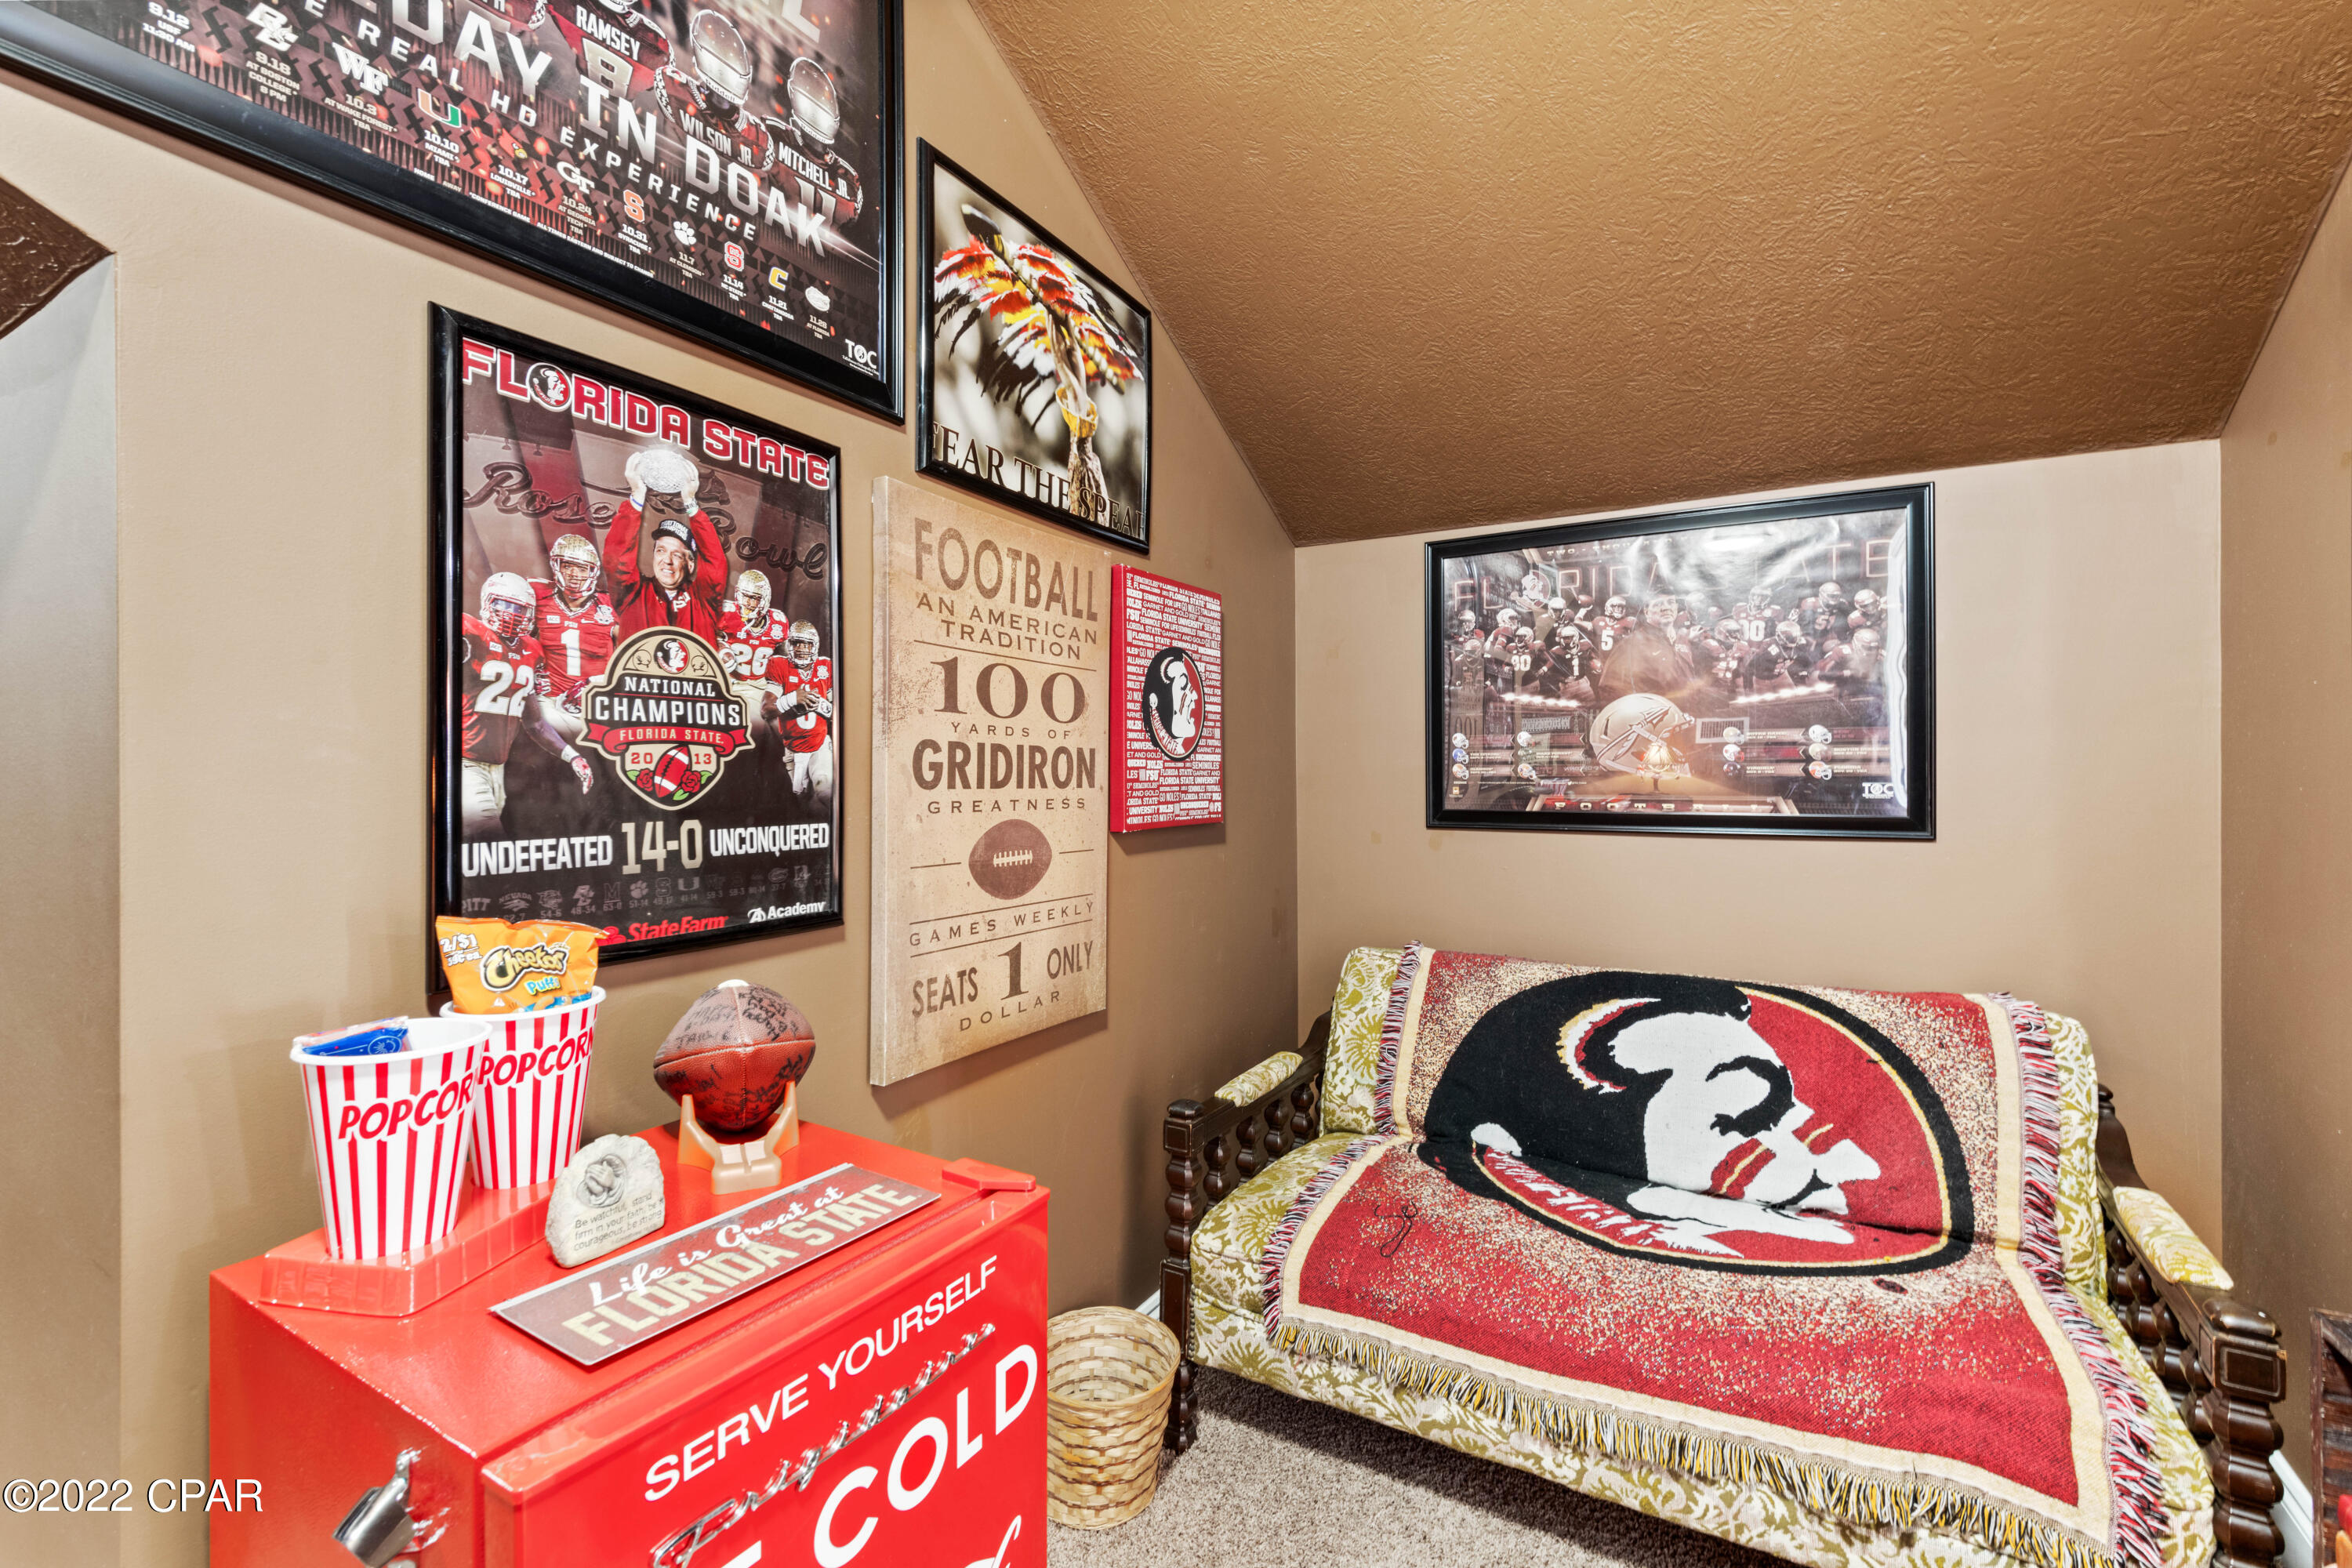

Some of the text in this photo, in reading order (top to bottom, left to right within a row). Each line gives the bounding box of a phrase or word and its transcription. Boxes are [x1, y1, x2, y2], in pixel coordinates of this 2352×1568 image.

[147, 2, 190, 29] 9.12
[175, 38, 195, 53] AM
[576, 5, 641, 61] RAMSEY
[245, 60, 300, 90] AT BOSTON
[255, 50, 292, 76] 9.18
[269, 89, 287, 102] PM
[324, 97, 336, 107] AT
[335, 101, 363, 119] WAKE
[345, 93, 377, 116] 10.3
[352, 118, 372, 132] TBA
[424, 129, 459, 154] 10.10
[679, 109, 755, 168] WILSON JR.
[434, 154, 451, 167] TBA
[491, 89, 537, 127] HD
[560, 125, 757, 241] EXPERIENCE
[579, 74, 826, 257] IN DOAK
[779, 142, 833, 191] MITCHELL
[414, 167, 436, 181] HOME
[497, 164, 529, 186] 10.17
[505, 187, 521, 199] TBA
[563, 194, 592, 216] 10.24
[513, 210, 532, 223] GAME
[557, 205, 597, 227] AT GEORGIA
[570, 224, 584, 236] TBA
[622, 223, 648, 244] 10.31
[536, 221, 547, 230] ALL
[547, 227, 567, 239] TIMES
[567, 235, 592, 251] EASTERN
[591, 245, 604, 256] AND
[603, 251, 627, 267] SUBJECT
[626, 260, 635, 269] TO
[629, 244, 641, 255] TBA
[678, 251, 695, 266] 11.7
[723, 274, 744, 290] 11.14
[768, 295, 788, 311] 11.21
[844, 338, 877, 369] TOC
[462, 336, 830, 491] FLORIDA STATE
[1014, 457, 1072, 510] THE
[914, 517, 1098, 622] FOOTBALL
[1142, 601, 1189, 619] GARNET AND GOLD
[1169, 592, 1189, 604] FLORIDA
[915, 593, 955, 616] AN
[969, 606, 1098, 645] AMERICAN
[1142, 608, 1162, 622] FLORIDA
[1163, 613, 1177, 625] STATE
[941, 619, 1081, 660] TRADITION
[1132, 630, 1154, 643] FLORIDA
[1600, 630, 1614, 651] 5
[561, 628, 582, 677] 1
[730, 642, 774, 677] 26
[474, 659, 535, 718] 22
[624, 676, 716, 697] NATIONAL
[930, 655, 1086, 724] 100
[595, 696, 740, 726] CHAMPIONS
[620, 728, 677, 741] FLORIDA
[951, 721, 1072, 740] YARDS OF
[912, 739, 1096, 790] GRIDIRON
[928, 798, 1086, 814] GREATNESS
[462, 818, 829, 877] UNDEFEATED 14-0 UNCONQUERED
[499, 891, 532, 904] NEVADA
[768, 900, 827, 920] Academy
[909, 902, 1094, 947] GAMES WEEKLY
[439, 933, 477, 953] 2/$1
[484, 944, 566, 989] Cheetos
[525, 976, 560, 995] Puffs
[912, 940, 1094, 1019] SEATS 1 ONLY
[960, 991, 1061, 1033] DOLLAR
[339, 1071, 476, 1139] POPCOR
[575, 1218, 588, 1229] Be
[632, 1192, 652, 1207] stand
[575, 1229, 593, 1240] firm
[606, 1215, 625, 1229] your
[590, 1186, 844, 1305] Life is Great at
[561, 1182, 919, 1347] FLORIDA STATE
[644, 1255, 997, 1502] SERVE YOURSELF
[813, 1344, 1038, 1568] COLD
